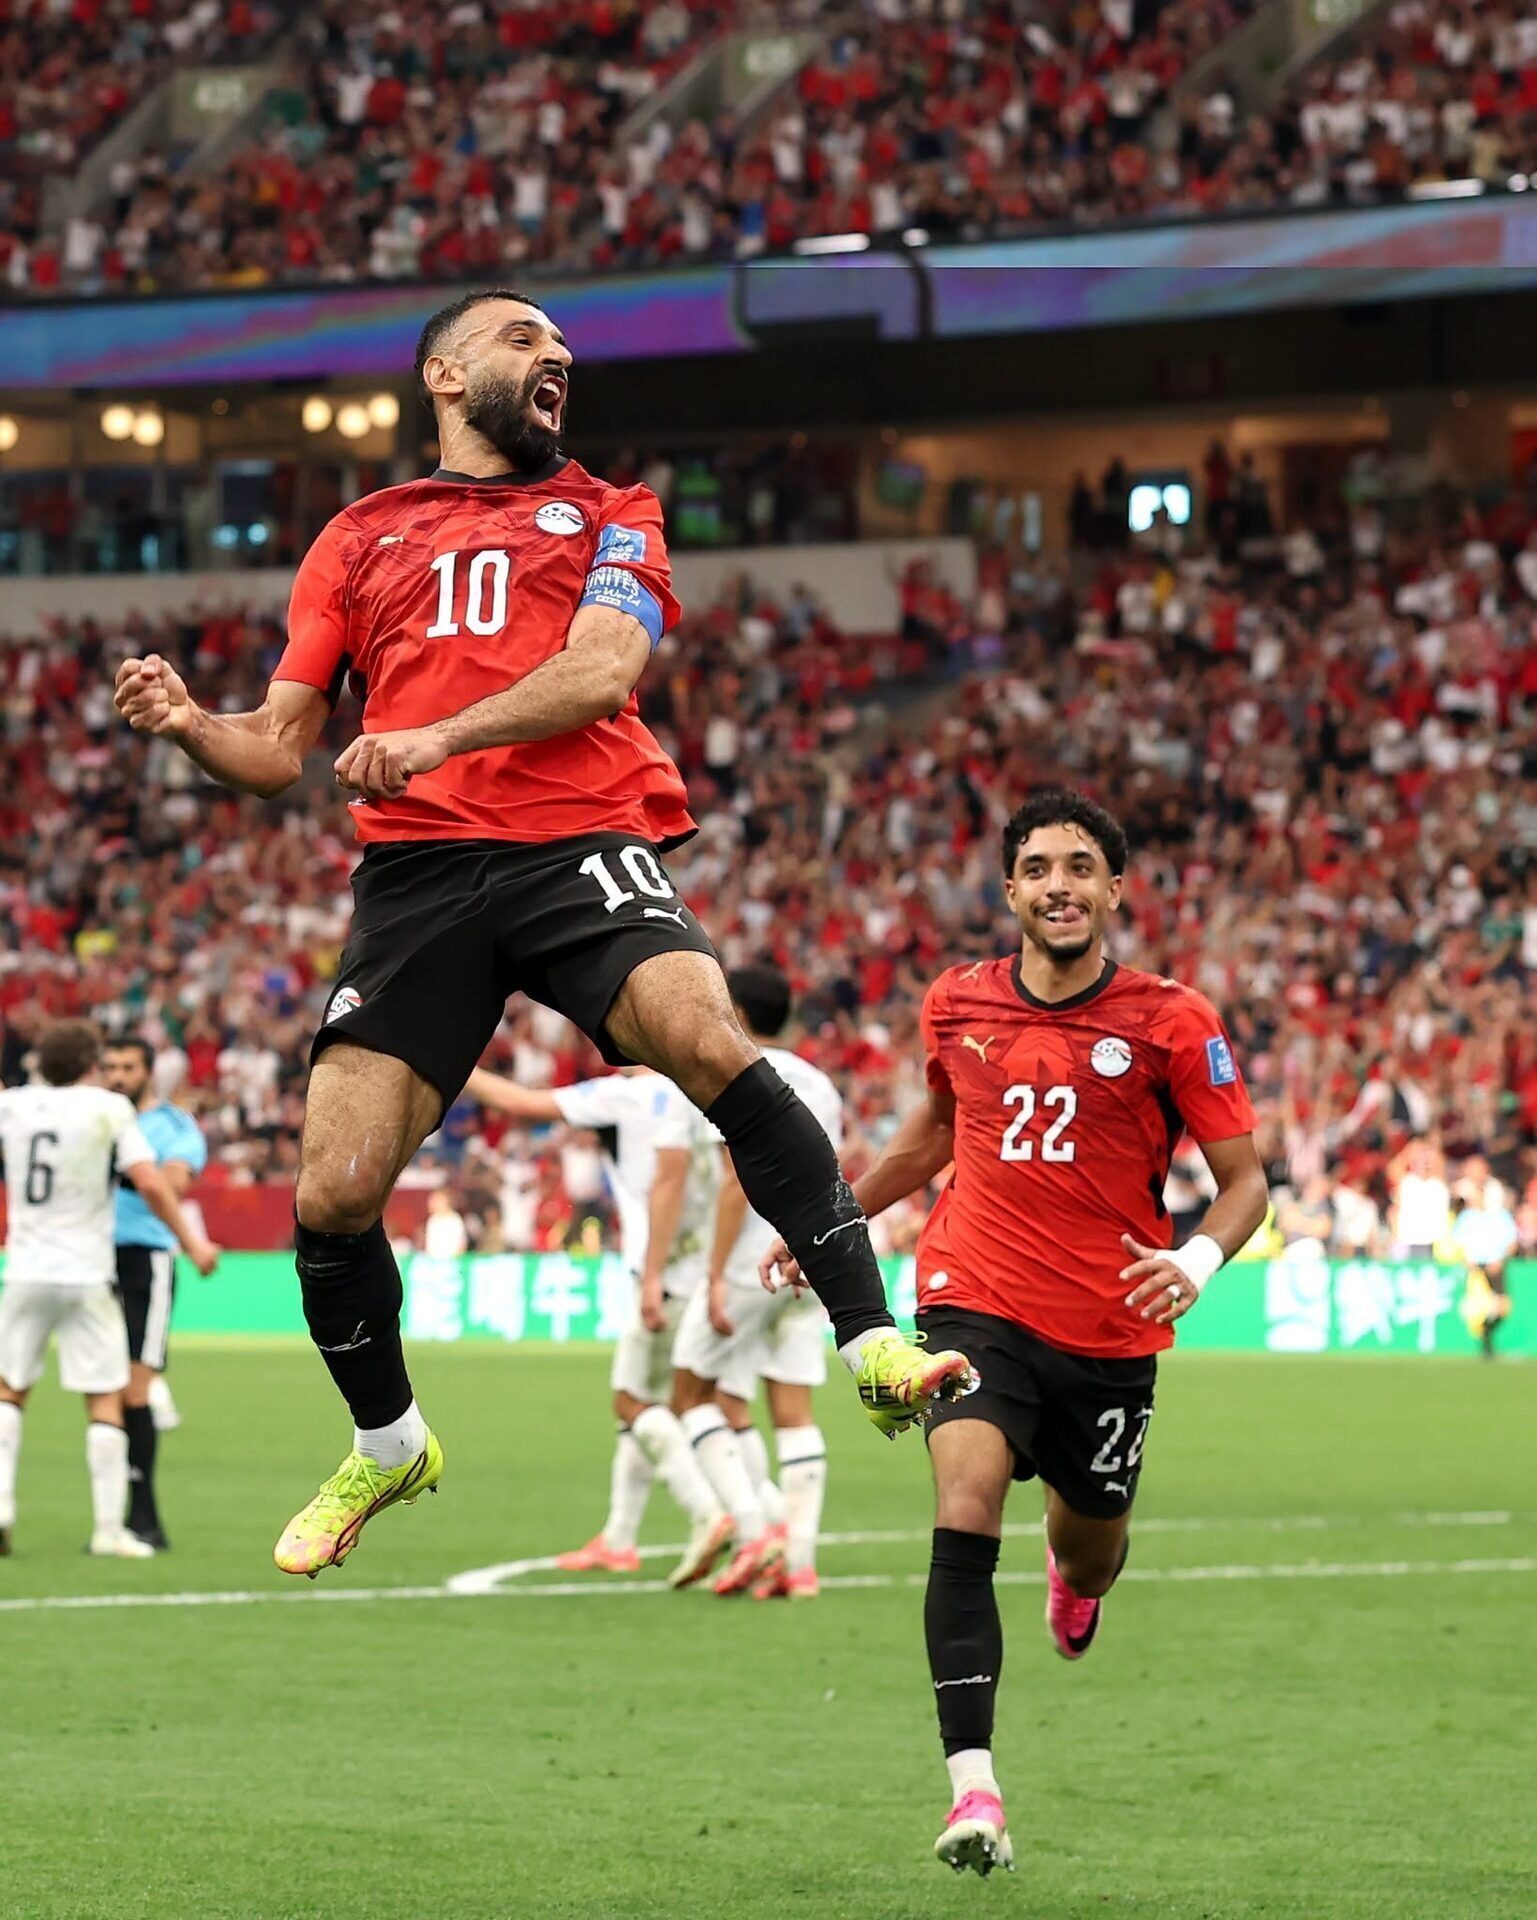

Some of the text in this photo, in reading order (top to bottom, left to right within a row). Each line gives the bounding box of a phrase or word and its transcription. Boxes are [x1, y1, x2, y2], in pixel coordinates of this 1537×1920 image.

[426, 550, 510, 638] 10
[585, 573, 640, 597] UNITES
[603, 587, 641, 606] World
[578, 845, 674, 913] 10
[1000, 1085, 1077, 1162] 22
[26, 1131, 60, 1205] 6
